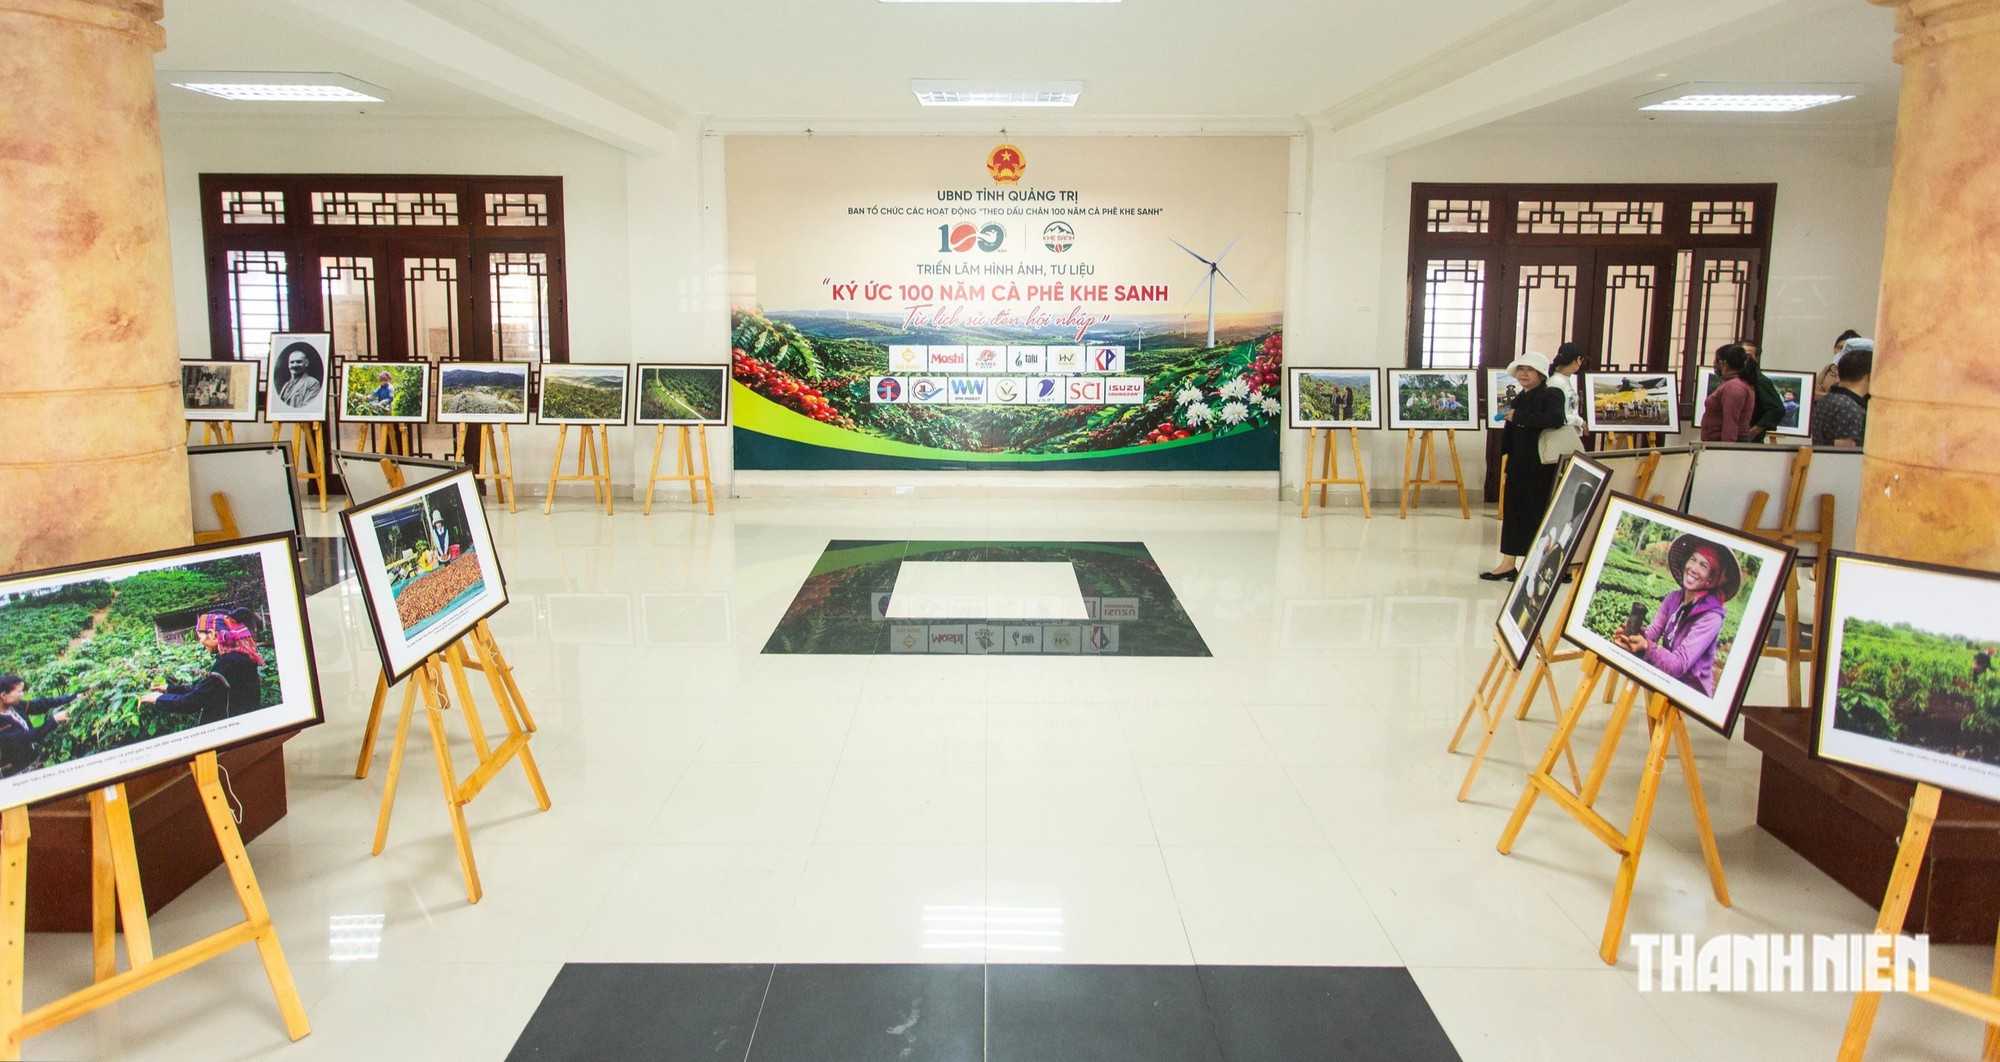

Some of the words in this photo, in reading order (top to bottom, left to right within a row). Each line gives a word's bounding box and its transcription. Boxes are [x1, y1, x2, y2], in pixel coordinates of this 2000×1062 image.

[937, 190, 973, 201] UBND
[975, 187, 1005, 201] TỈNH
[1008, 187, 1056, 202] QUẢNG
[1059, 190, 1078, 204] TRỊ
[848, 207, 865, 215] BAN
[880, 206, 905, 215] CHỨC
[906, 206, 925, 215] CÁC
[926, 207, 949, 217] HOẠT
[951, 206, 977, 217] ĐỘNG
[1006, 205, 1024, 215] DẤU
[1026, 206, 1050, 215] CHÂN
[1068, 206, 1086, 215] NĂM
[1088, 205, 1100, 215] CÀ
[1102, 206, 1118, 215] PHÊ
[916, 260, 951, 275] TRIỂN
[984, 262, 1013, 275] HÌNH
[1050, 263, 1067, 275] TƯ
[1069, 262, 1095, 278] LIỆU
[864, 280, 893, 301] ỨC
[898, 284, 934, 301] 100
[940, 281, 985, 301] NĂM
[991, 281, 1021, 302] CÀ
[1027, 281, 1064, 301] PHÊ
[1070, 285, 1109, 301] KHE
[1114, 285, 1168, 302] SANH
[932, 305, 964, 329] lịch
[989, 308, 1020, 327] đến
[1024, 305, 1051, 329] hội
[930, 353, 965, 364] Moshi
[1025, 353, 1038, 363] talu
[1059, 354, 1074, 362] HV
[1070, 382, 1101, 400] SCI
